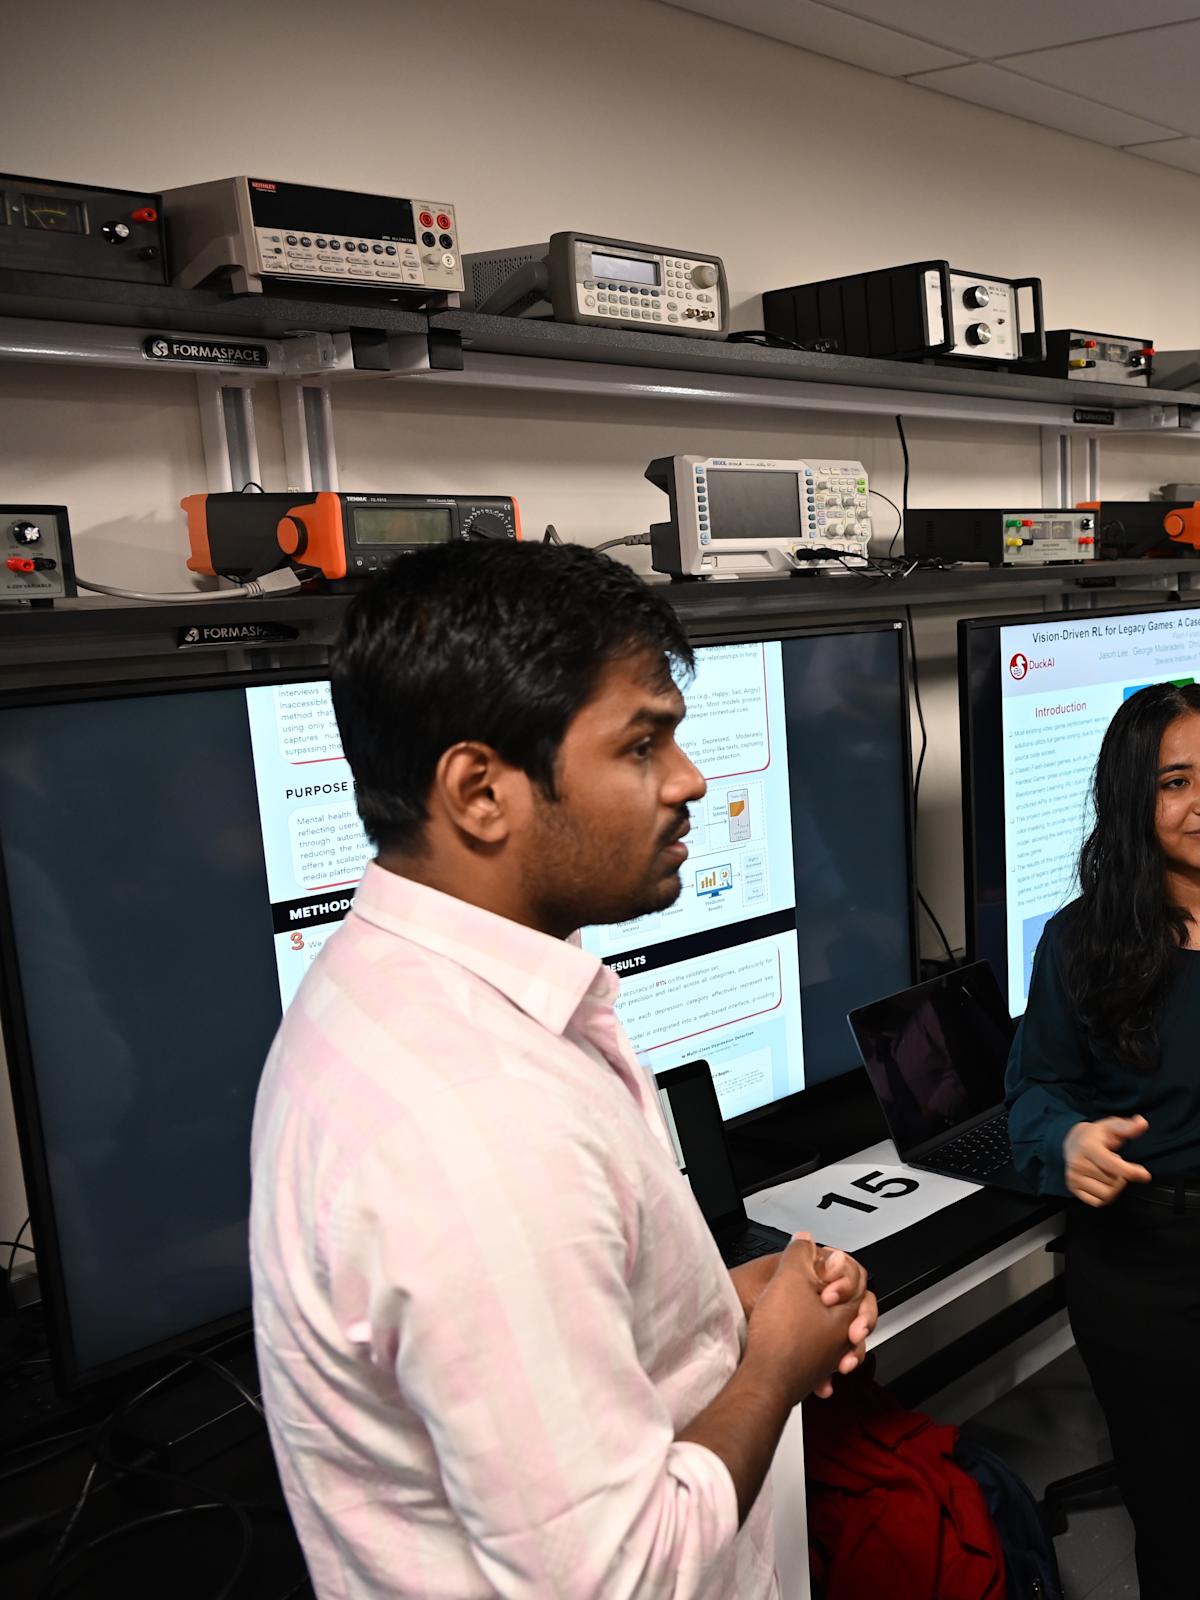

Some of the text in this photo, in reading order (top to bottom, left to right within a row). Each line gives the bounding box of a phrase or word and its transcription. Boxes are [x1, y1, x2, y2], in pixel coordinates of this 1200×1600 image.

[172, 344, 260, 361] FORMASPACE
[1032, 629, 1090, 643] Vision-Driven
[1092, 626, 1102, 637] RL
[1106, 625, 1116, 636] for
[1118, 624, 1146, 636] Legacy
[1148, 620, 1174, 631] Games:
[1178, 619, 1184, 628] A
[1185, 618, 1200, 627] Case
[1029, 658, 1055, 670] DuckAI
[278, 688, 319, 698] interviews
[280, 698, 328, 710] inaccessible
[1036, 702, 1086, 718] Introduction
[281, 710, 333, 720] method that
[282, 722, 324, 733] using only
[284, 734, 318, 745] captures
[285, 744, 326, 756] surpassing
[286, 782, 348, 799] PURPOSE
[297, 811, 352, 826] Mental health
[298, 826, 336, 837] reflecting
[299, 837, 330, 848] through
[300, 848, 336, 860] reducing
[302, 862, 324, 871] offers
[303, 870, 327, 881] media
[624, 986, 648, 998] accuracy
[686, 968, 710, 978] validation
[628, 994, 653, 1007] precision
[655, 990, 666, 998] and
[668, 986, 682, 994] recall
[638, 1012, 652, 1021] each
[654, 1002, 684, 1016] depression
[686, 995, 709, 1006] category
[711, 1038, 734, 1050] Depression
[734, 1031, 754, 1042] Detection
[816, 1170, 920, 1214] 15
